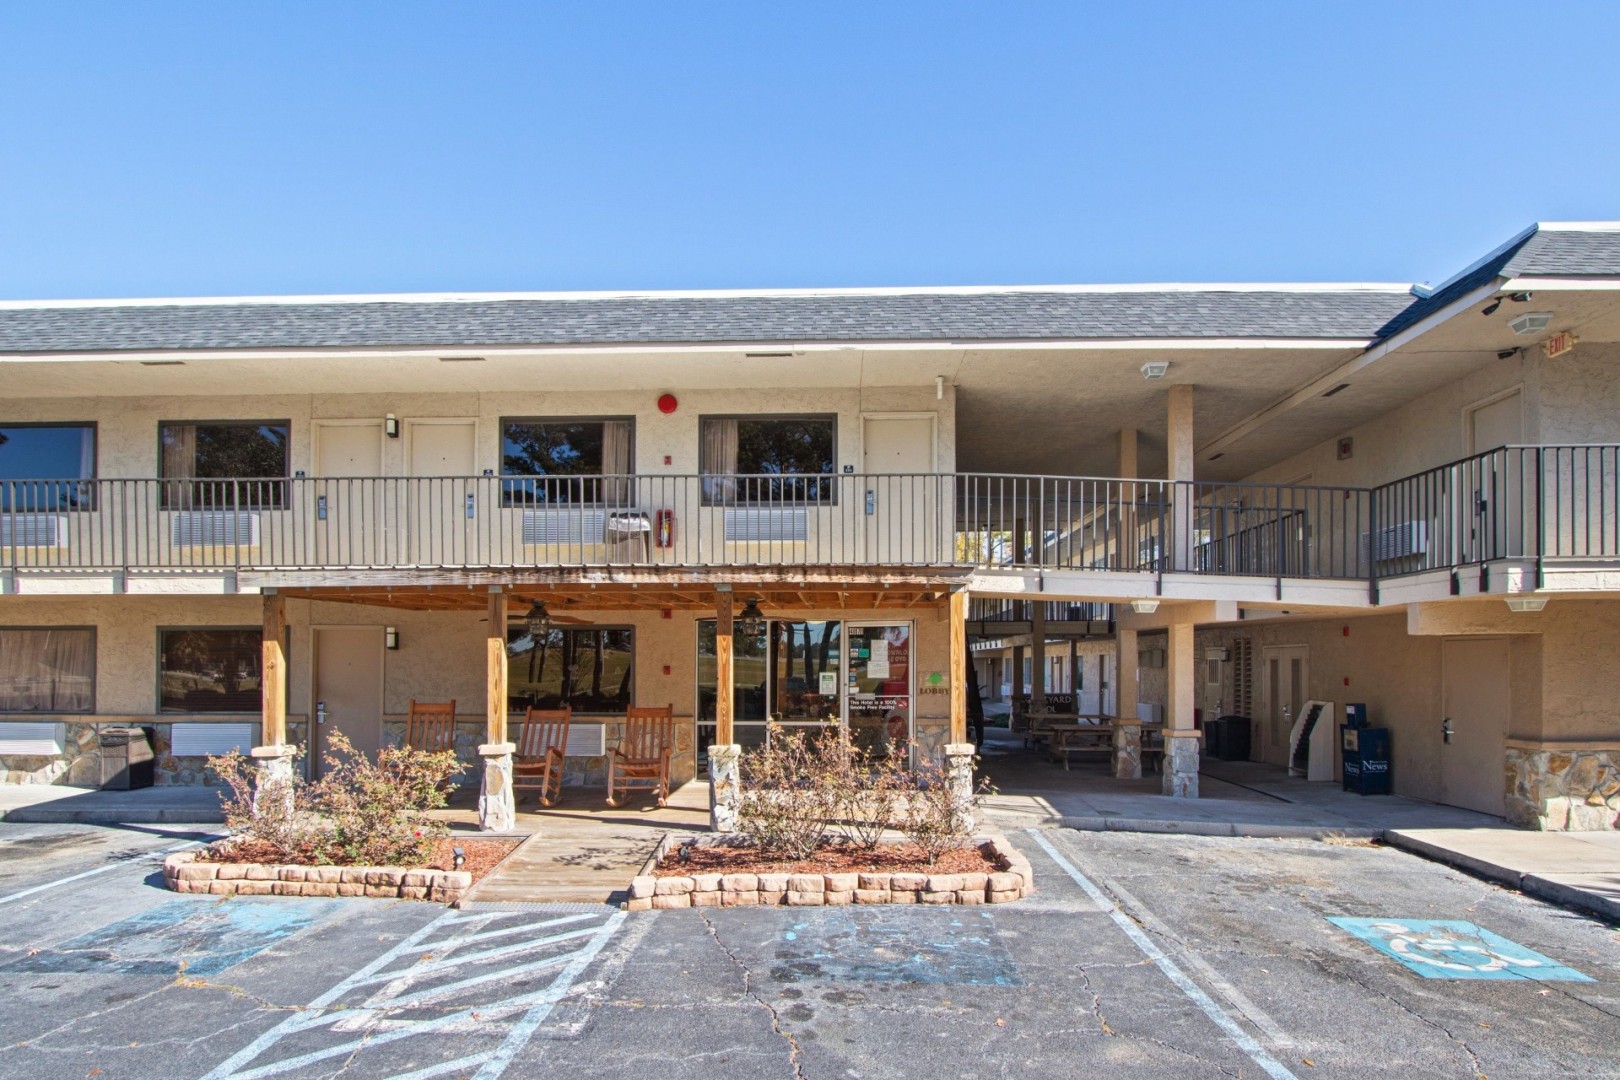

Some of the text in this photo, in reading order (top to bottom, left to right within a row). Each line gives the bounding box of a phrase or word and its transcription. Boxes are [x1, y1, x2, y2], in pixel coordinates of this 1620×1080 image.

[1550, 334, 1566, 355] EXIT
[919, 687, 949, 695] LOBBY
[1025, 696, 1072, 704] CYARD
[1344, 762, 1360, 773] News
[1362, 760, 1388, 771] News
